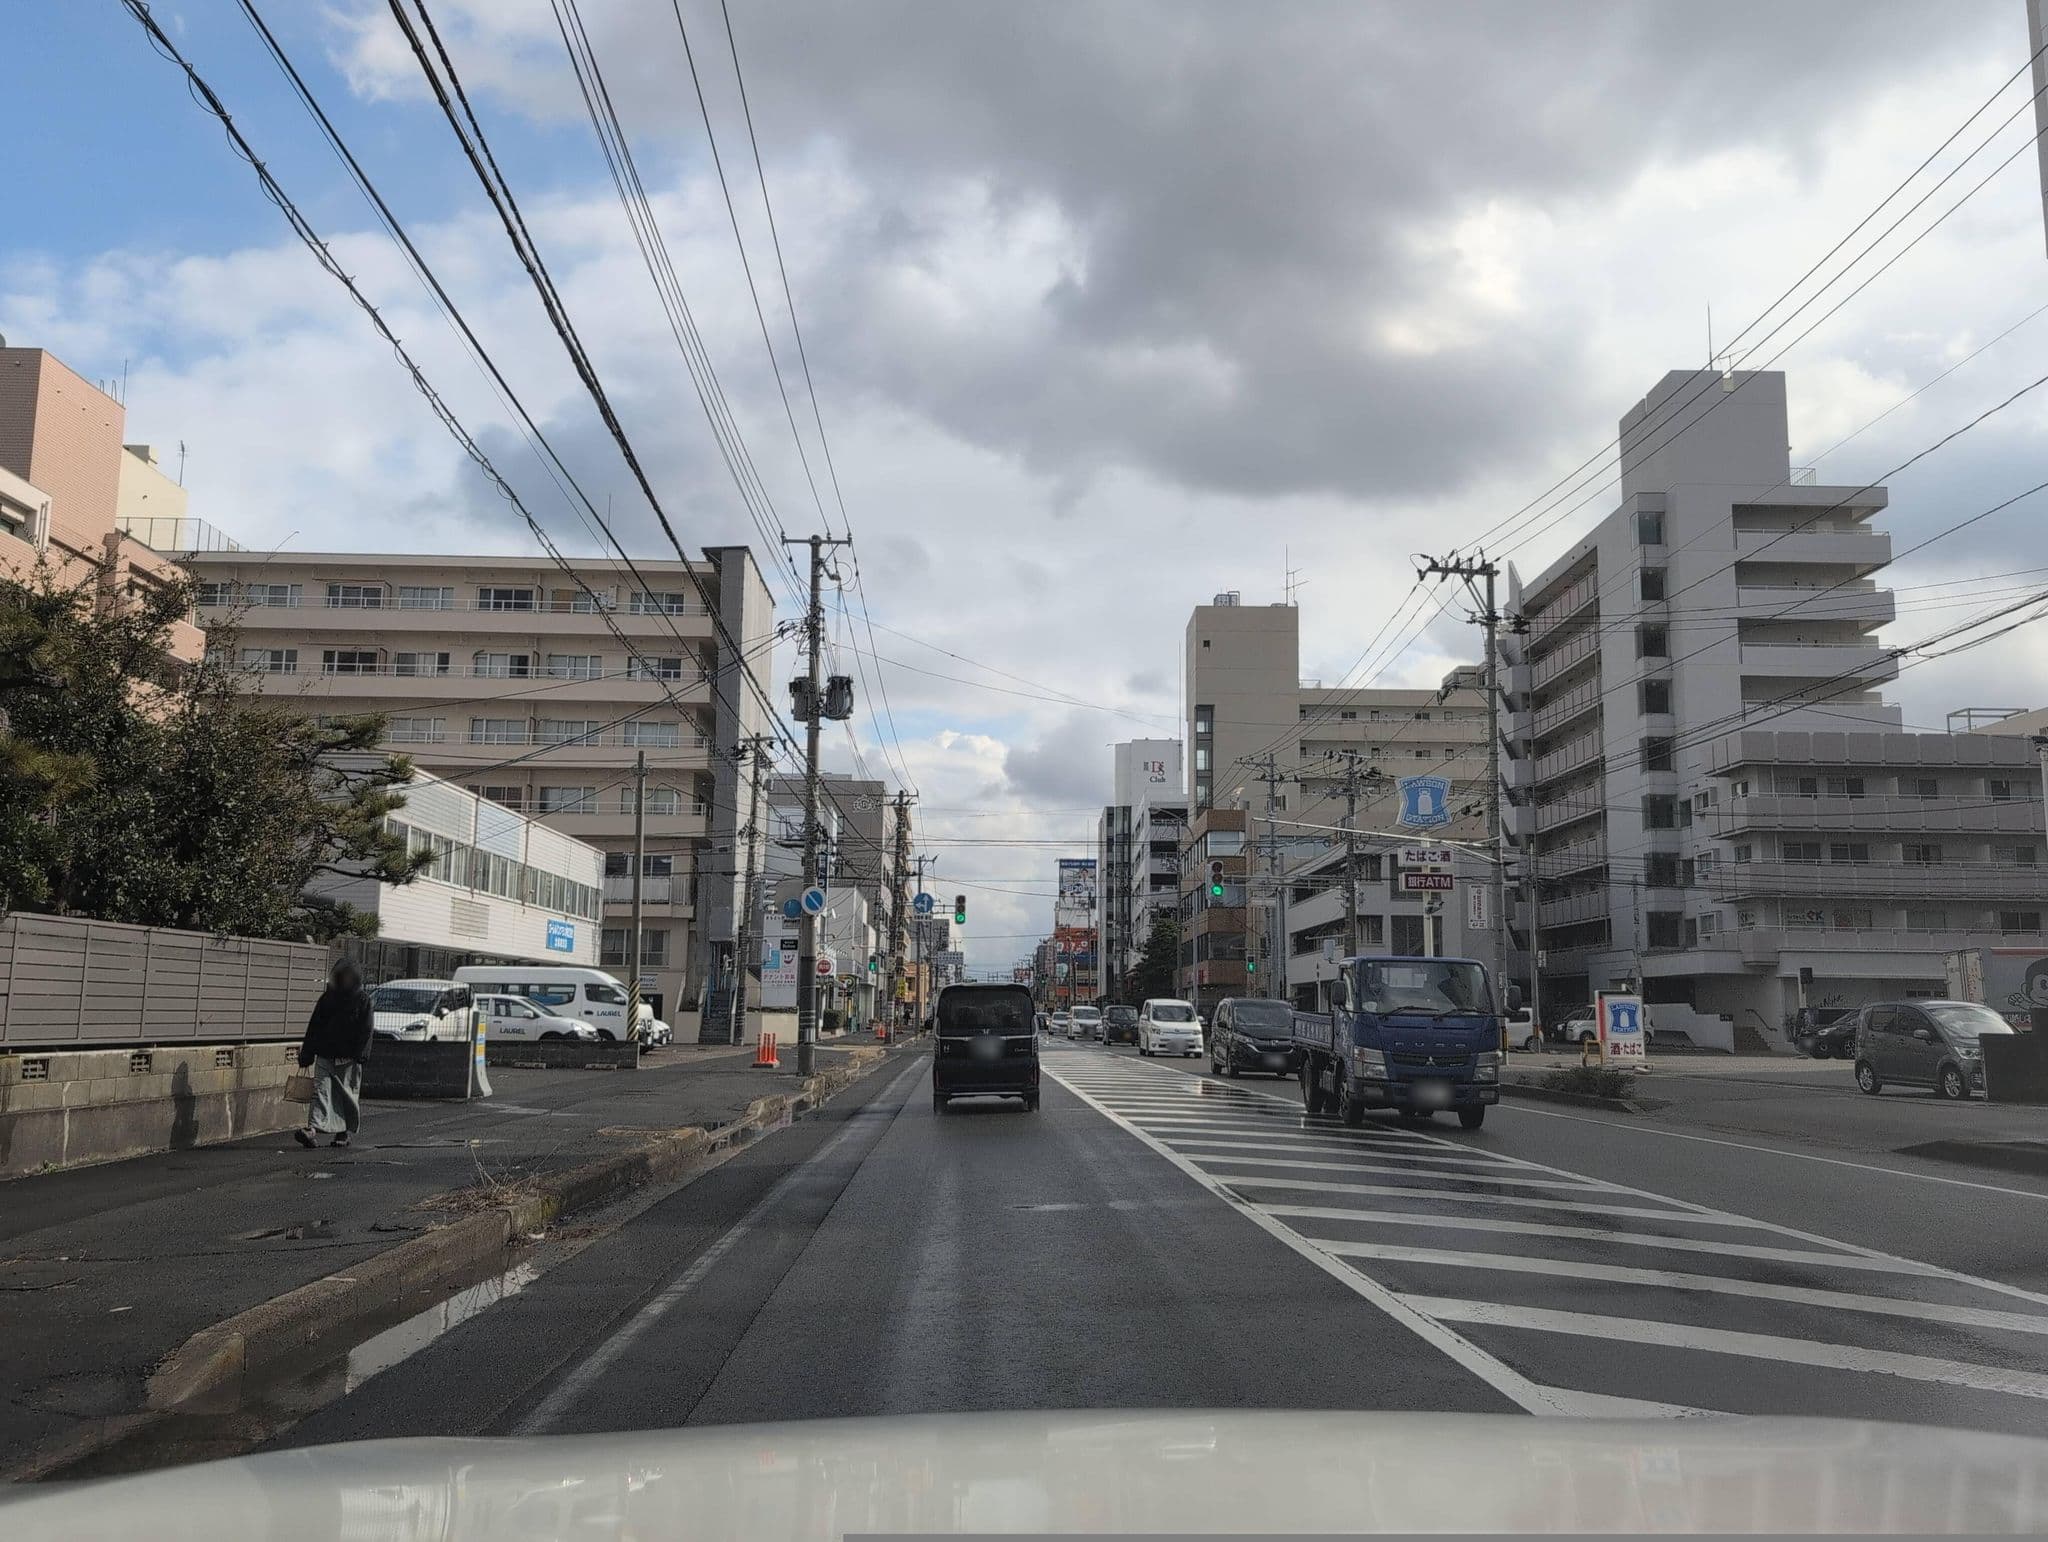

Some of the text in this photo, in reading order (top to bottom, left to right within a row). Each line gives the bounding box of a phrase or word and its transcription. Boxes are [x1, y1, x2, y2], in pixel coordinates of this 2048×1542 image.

[1403, 779, 1445, 790] LAWSON
[1405, 813, 1445, 823] STATION
[1407, 875, 1451, 887] 銀行ATM
[500, 1027, 525, 1035] LAUREL
[1610, 1042, 1642, 1054] 酒・たばこ
